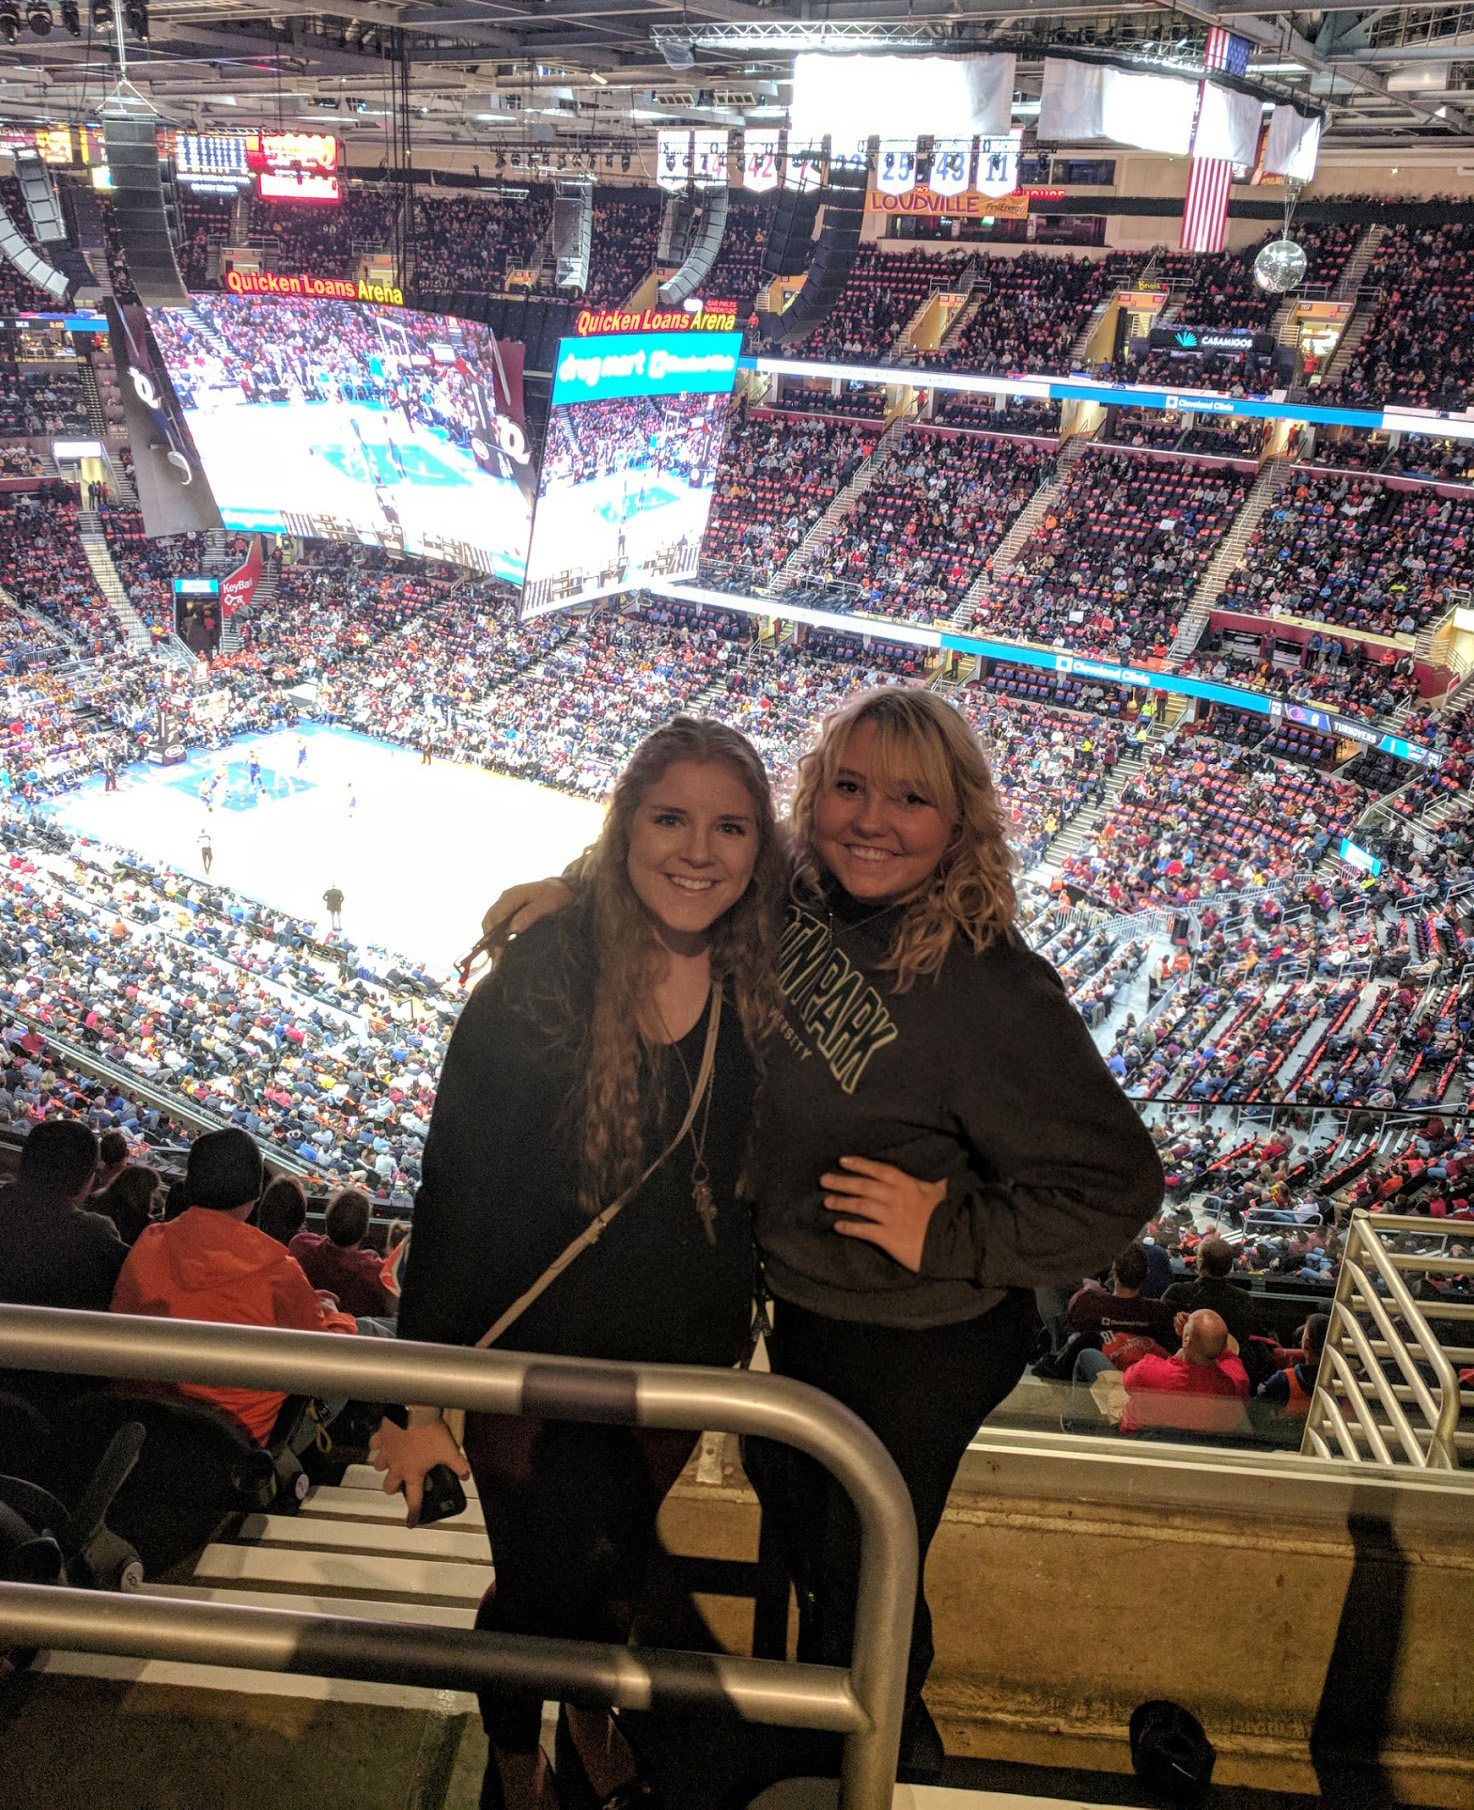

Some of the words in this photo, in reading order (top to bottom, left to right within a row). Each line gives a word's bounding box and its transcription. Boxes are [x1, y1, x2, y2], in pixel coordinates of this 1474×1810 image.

[748, 153, 773, 178] 42
[882, 152, 911, 181] 25
[936, 152, 965, 181] 43
[985, 154, 1009, 182] 11
[871, 192, 980, 214] LOUDVILLE
[227, 271, 300, 294] Quicken
[303, 274, 356, 299] Loans
[358, 279, 404, 305] Arena
[577, 310, 641, 337] Quicken
[642, 308, 691, 331] Loans
[689, 310, 737, 332] Arena
[1201, 335, 1254, 349] CASAMIGOS
[558, 353, 601, 387] drug
[601, 349, 646, 378] mart
[1179, 398, 1214, 410] Cleveland
[1073, 661, 1122, 680] Cleveland
[1121, 670, 1151, 686] Clinic
[1333, 721, 1378, 745] TURNOVERS
